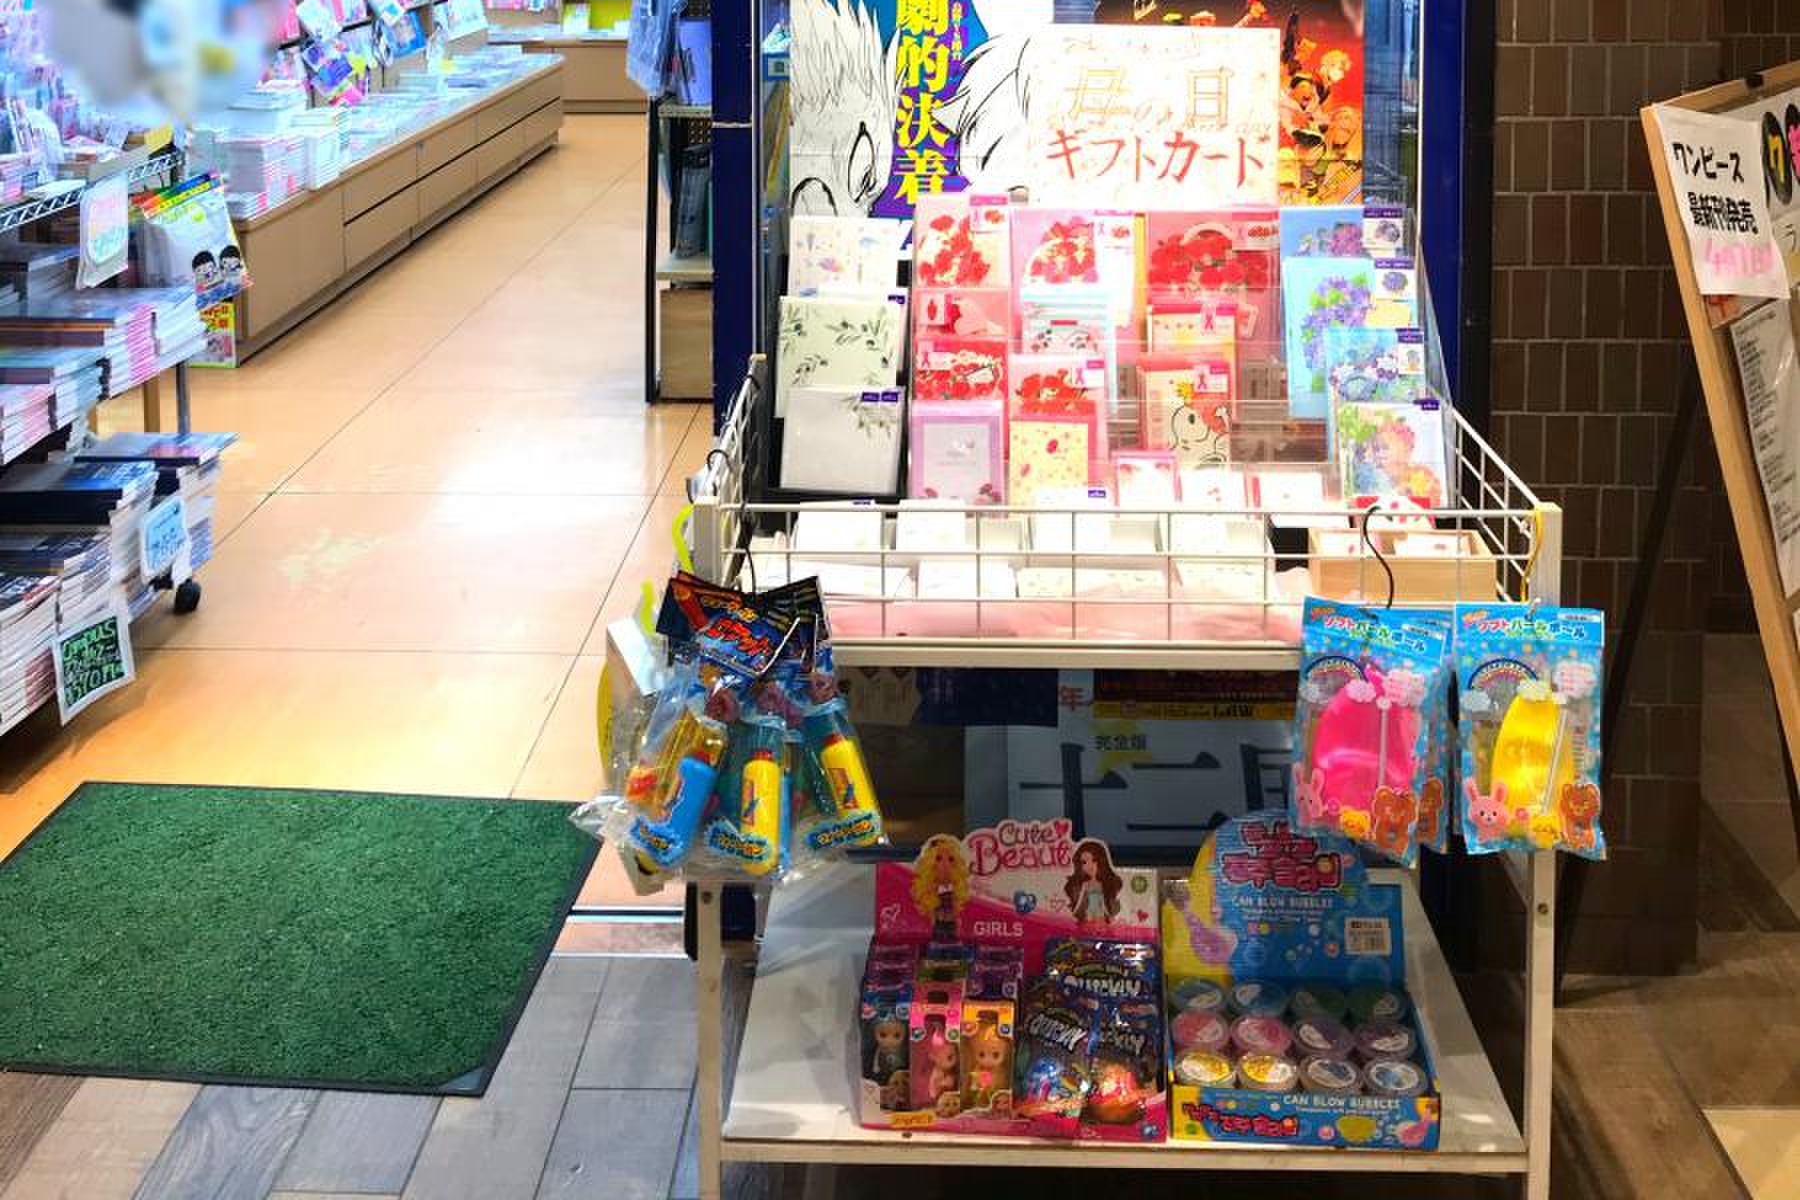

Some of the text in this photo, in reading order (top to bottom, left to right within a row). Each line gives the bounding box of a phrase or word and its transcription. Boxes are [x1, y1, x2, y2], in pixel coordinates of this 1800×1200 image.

[1046, 129, 1271, 188] ギフトカード
[1672, 141, 1745, 184] ワンピース
[999, 821, 1053, 846] Cute
[973, 920, 1025, 938] GIRLS
[1283, 1093, 1311, 1106] CAN
[1313, 1095, 1346, 1107] BLOW
